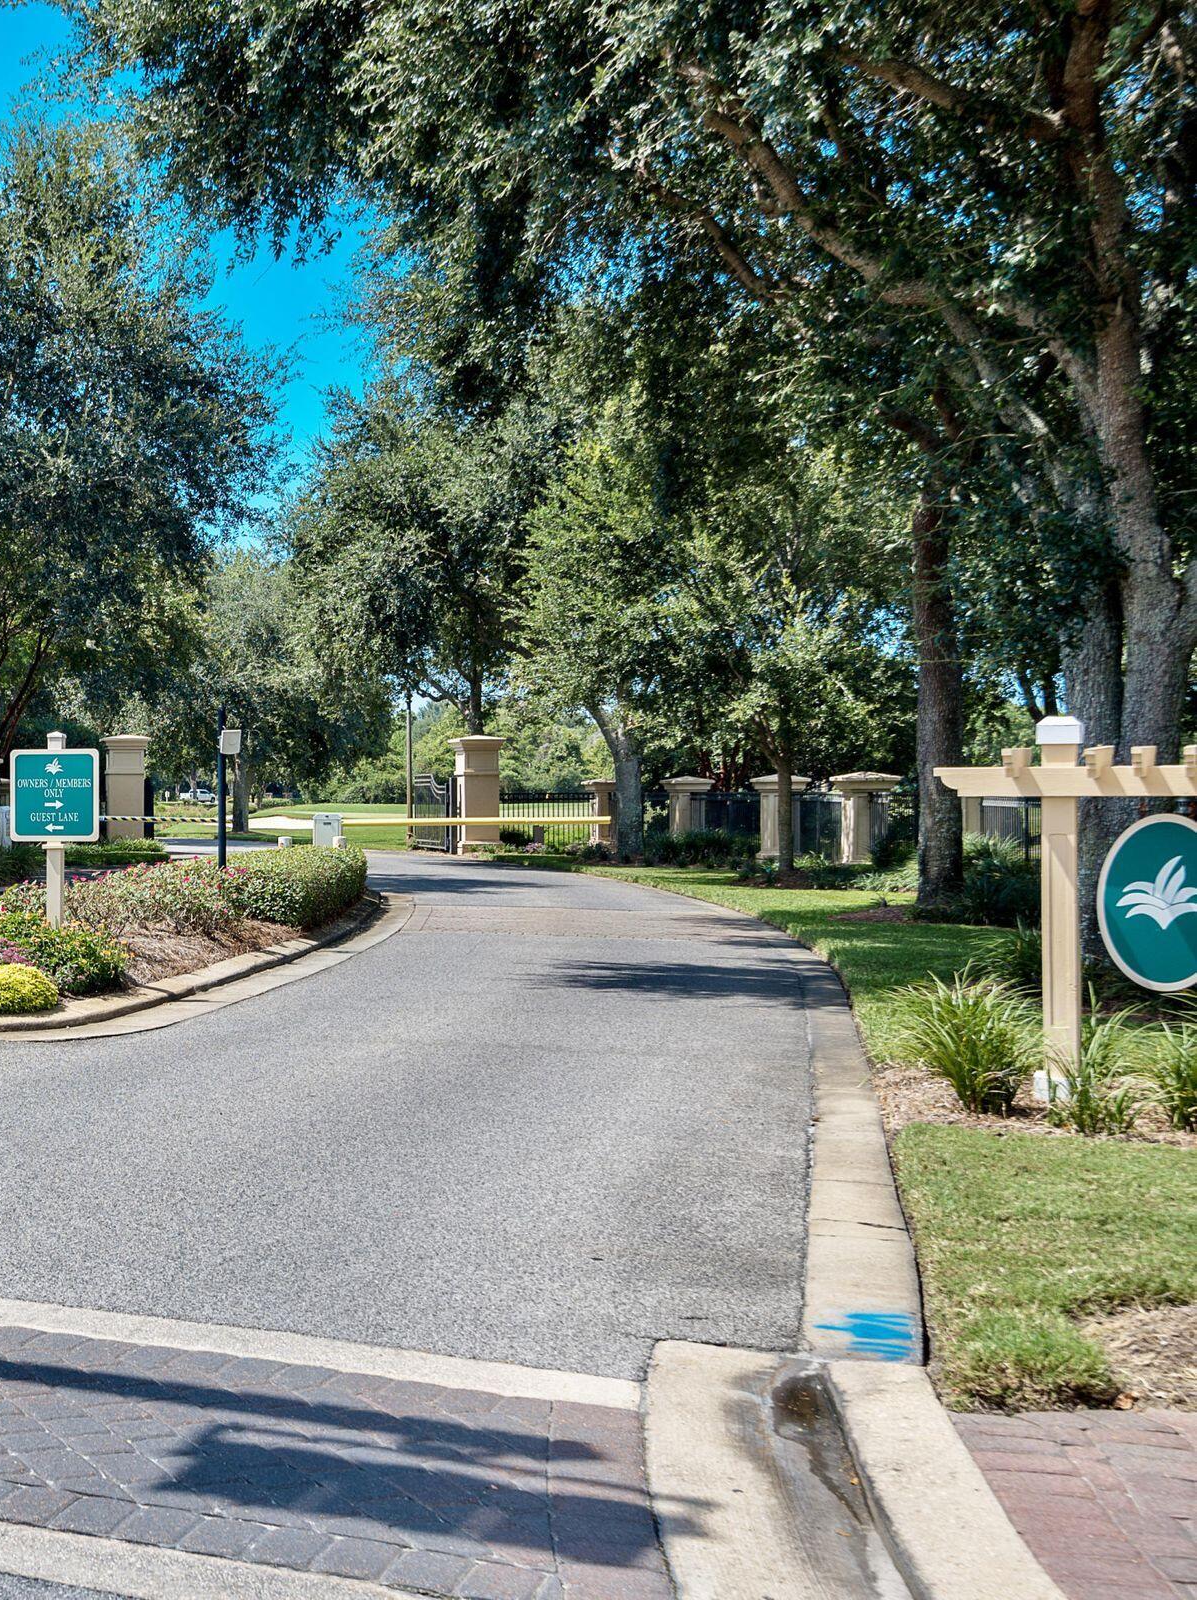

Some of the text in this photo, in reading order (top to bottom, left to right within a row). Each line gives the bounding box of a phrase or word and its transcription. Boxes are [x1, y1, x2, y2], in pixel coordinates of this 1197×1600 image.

[17, 779, 49, 788] OWNERS
[55, 779, 92, 788] MEMBERS
[44, 788, 64, 798] ONLY
[30, 812, 79, 822] GUEST LANE
